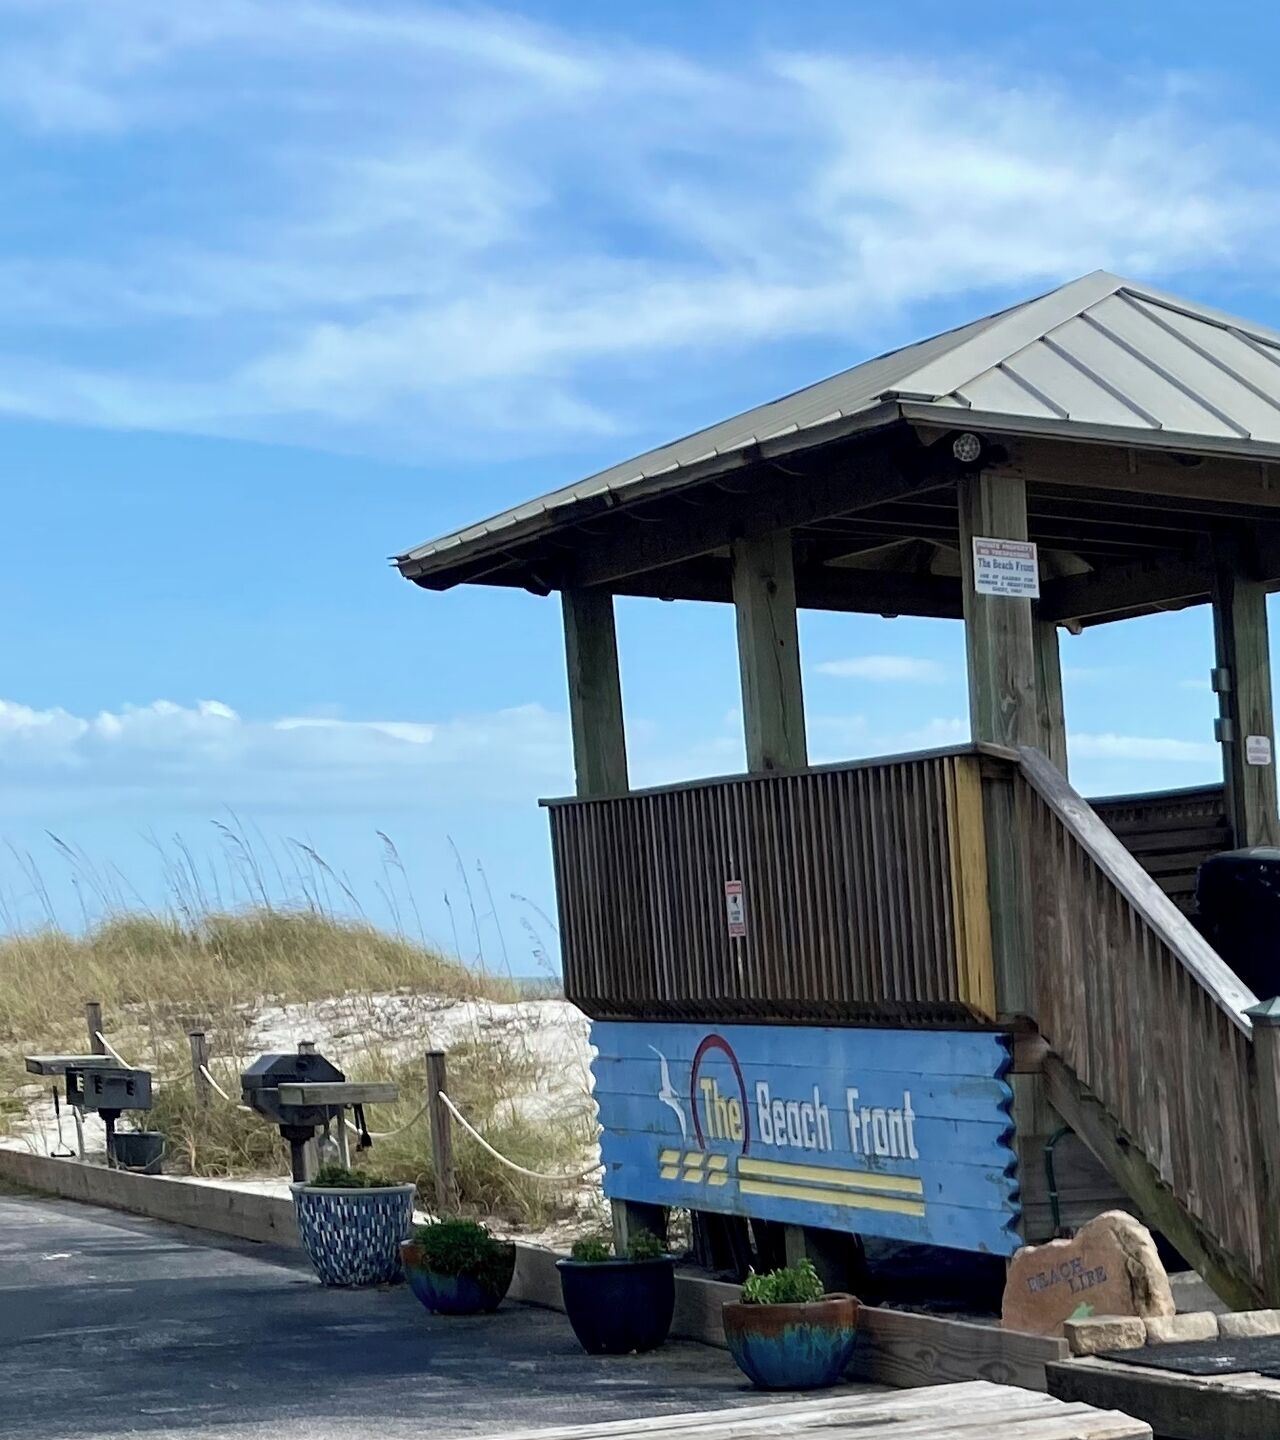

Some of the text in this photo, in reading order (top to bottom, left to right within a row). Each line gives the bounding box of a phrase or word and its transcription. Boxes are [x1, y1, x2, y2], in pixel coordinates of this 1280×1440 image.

[977, 557, 1034, 572] The Beach Front
[700, 1077, 919, 1160] The Beach Front
[1026, 1256, 1083, 1295] BEACH
[1067, 1266, 1107, 1295] LIFE
